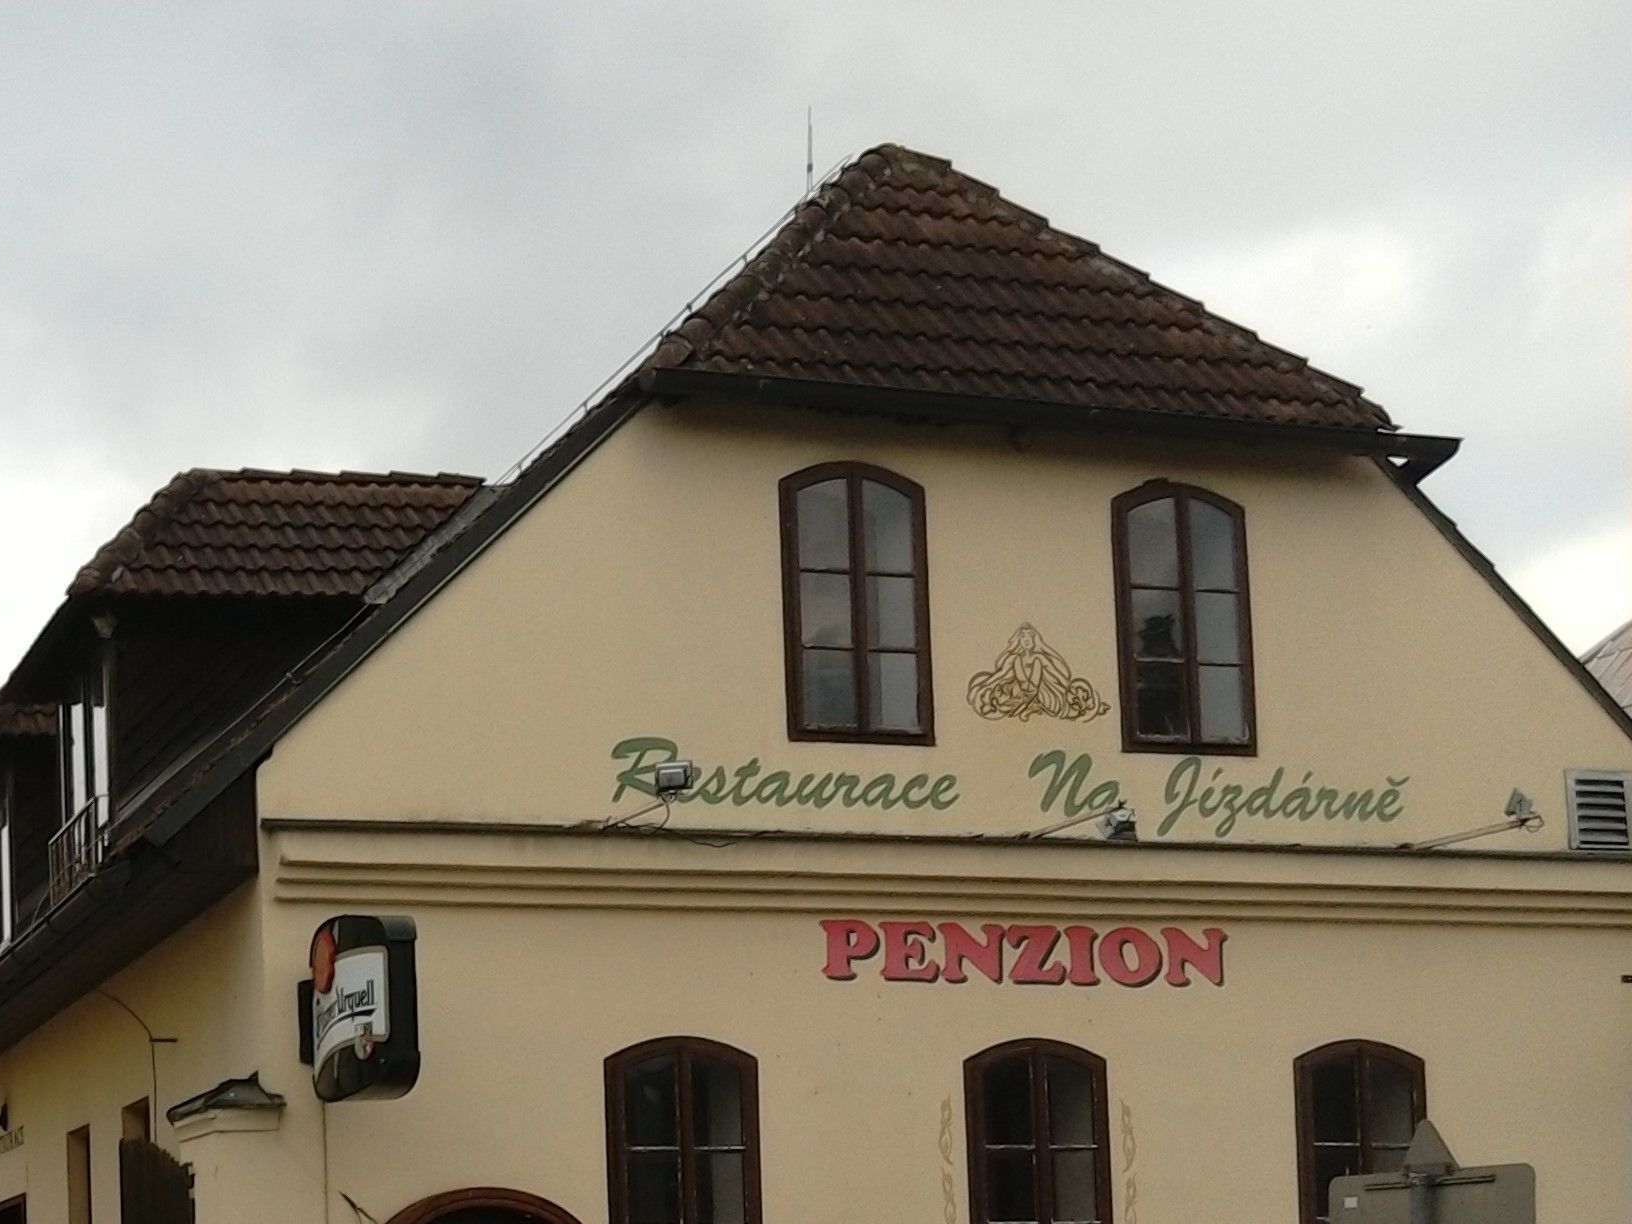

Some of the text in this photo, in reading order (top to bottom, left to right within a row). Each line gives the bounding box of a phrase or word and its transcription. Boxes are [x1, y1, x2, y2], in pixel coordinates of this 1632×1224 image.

[1029, 749, 1120, 817] Na
[1157, 756, 1410, 838] Jízdárně
[819, 918, 1229, 987] PENZION
